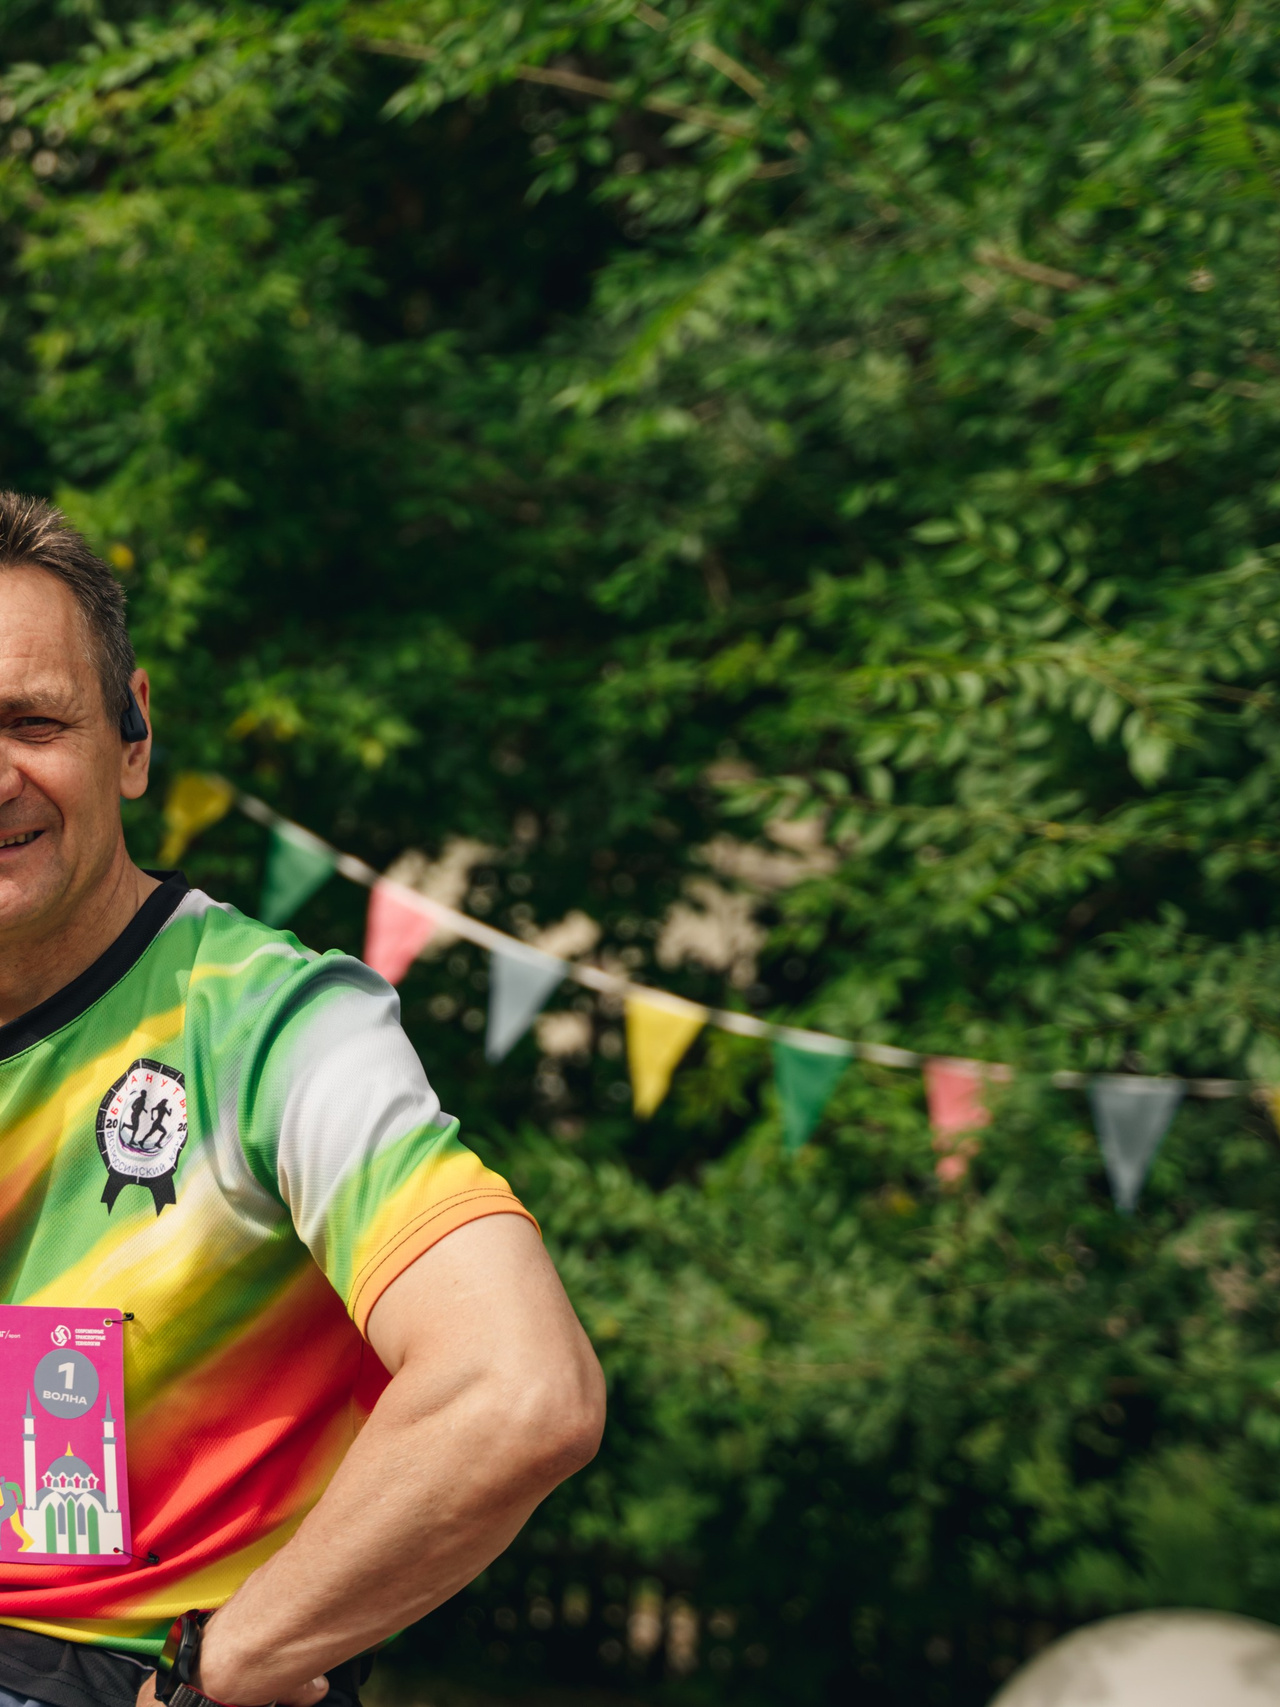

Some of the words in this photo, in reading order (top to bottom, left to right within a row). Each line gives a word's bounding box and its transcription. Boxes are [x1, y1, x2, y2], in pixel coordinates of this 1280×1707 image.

[105, 1119, 119, 1129] 20
[57, 1361, 75, 1390] 1
[42, 1390, 88, 1405] ВОЛНА
